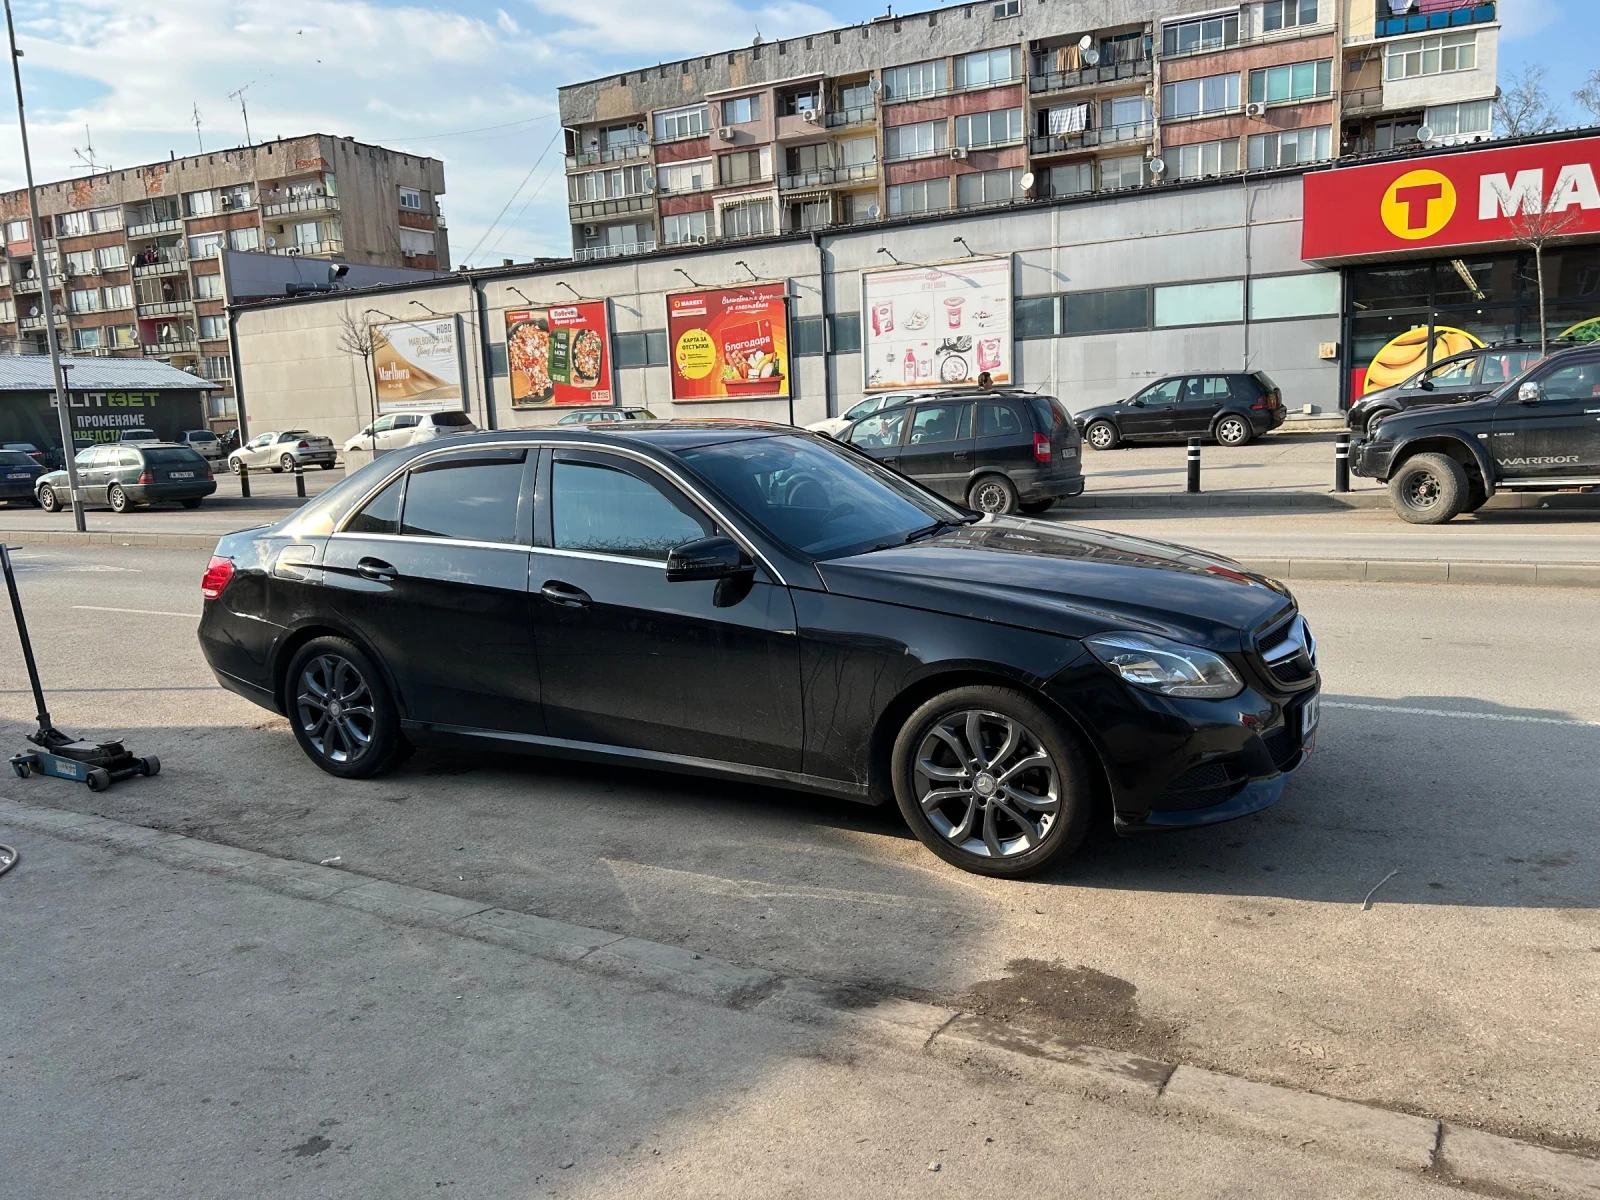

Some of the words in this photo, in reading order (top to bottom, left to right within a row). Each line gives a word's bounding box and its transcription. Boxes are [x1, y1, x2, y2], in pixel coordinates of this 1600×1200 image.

[725, 335, 770, 352] благодаря
[378, 361, 410, 381] Marlboro
[77, 414, 146, 428] ПРОМЕНЯМЕ
[1496, 455, 1579, 466] WARRIOR
